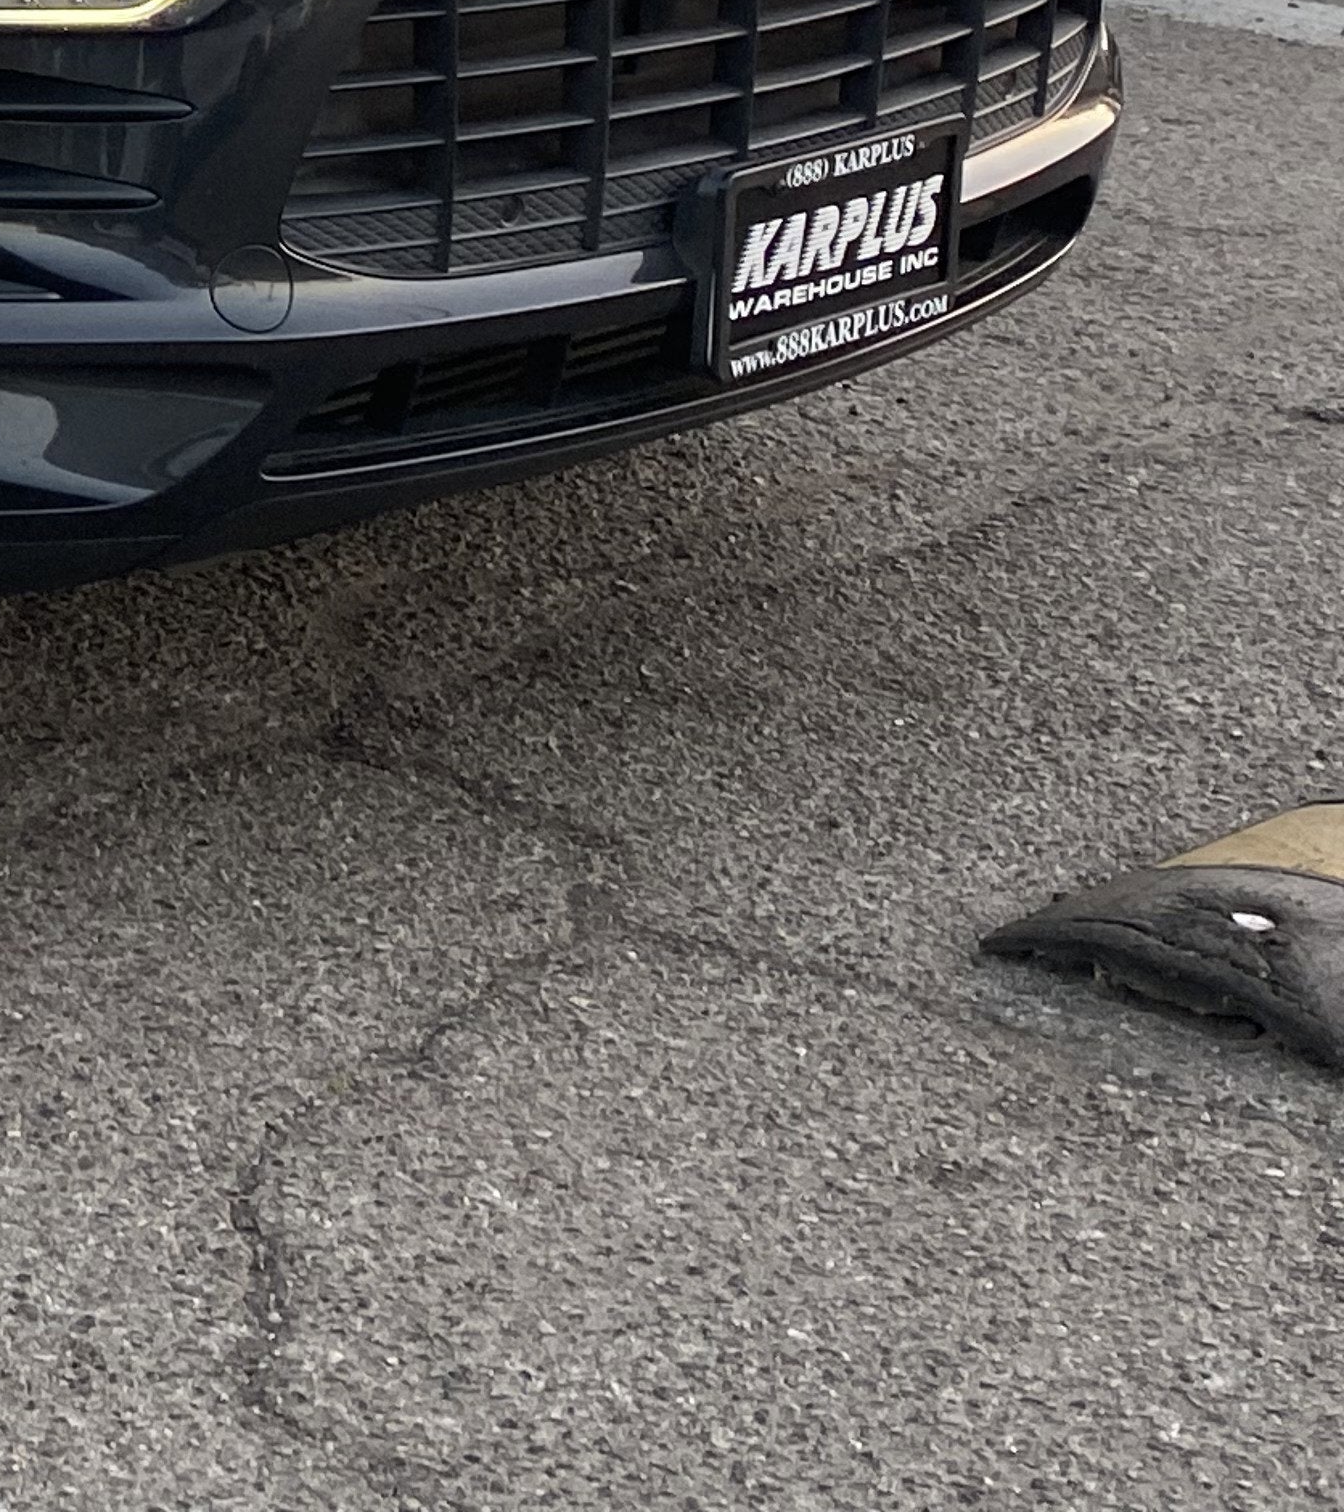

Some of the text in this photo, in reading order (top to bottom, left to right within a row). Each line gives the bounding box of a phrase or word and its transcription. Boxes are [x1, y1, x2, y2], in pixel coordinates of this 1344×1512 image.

[785, 134, 916, 189] (888) KARPLUS
[731, 174, 944, 294] KARPLUS
[728, 246, 940, 320] WAREHOUSE INC
